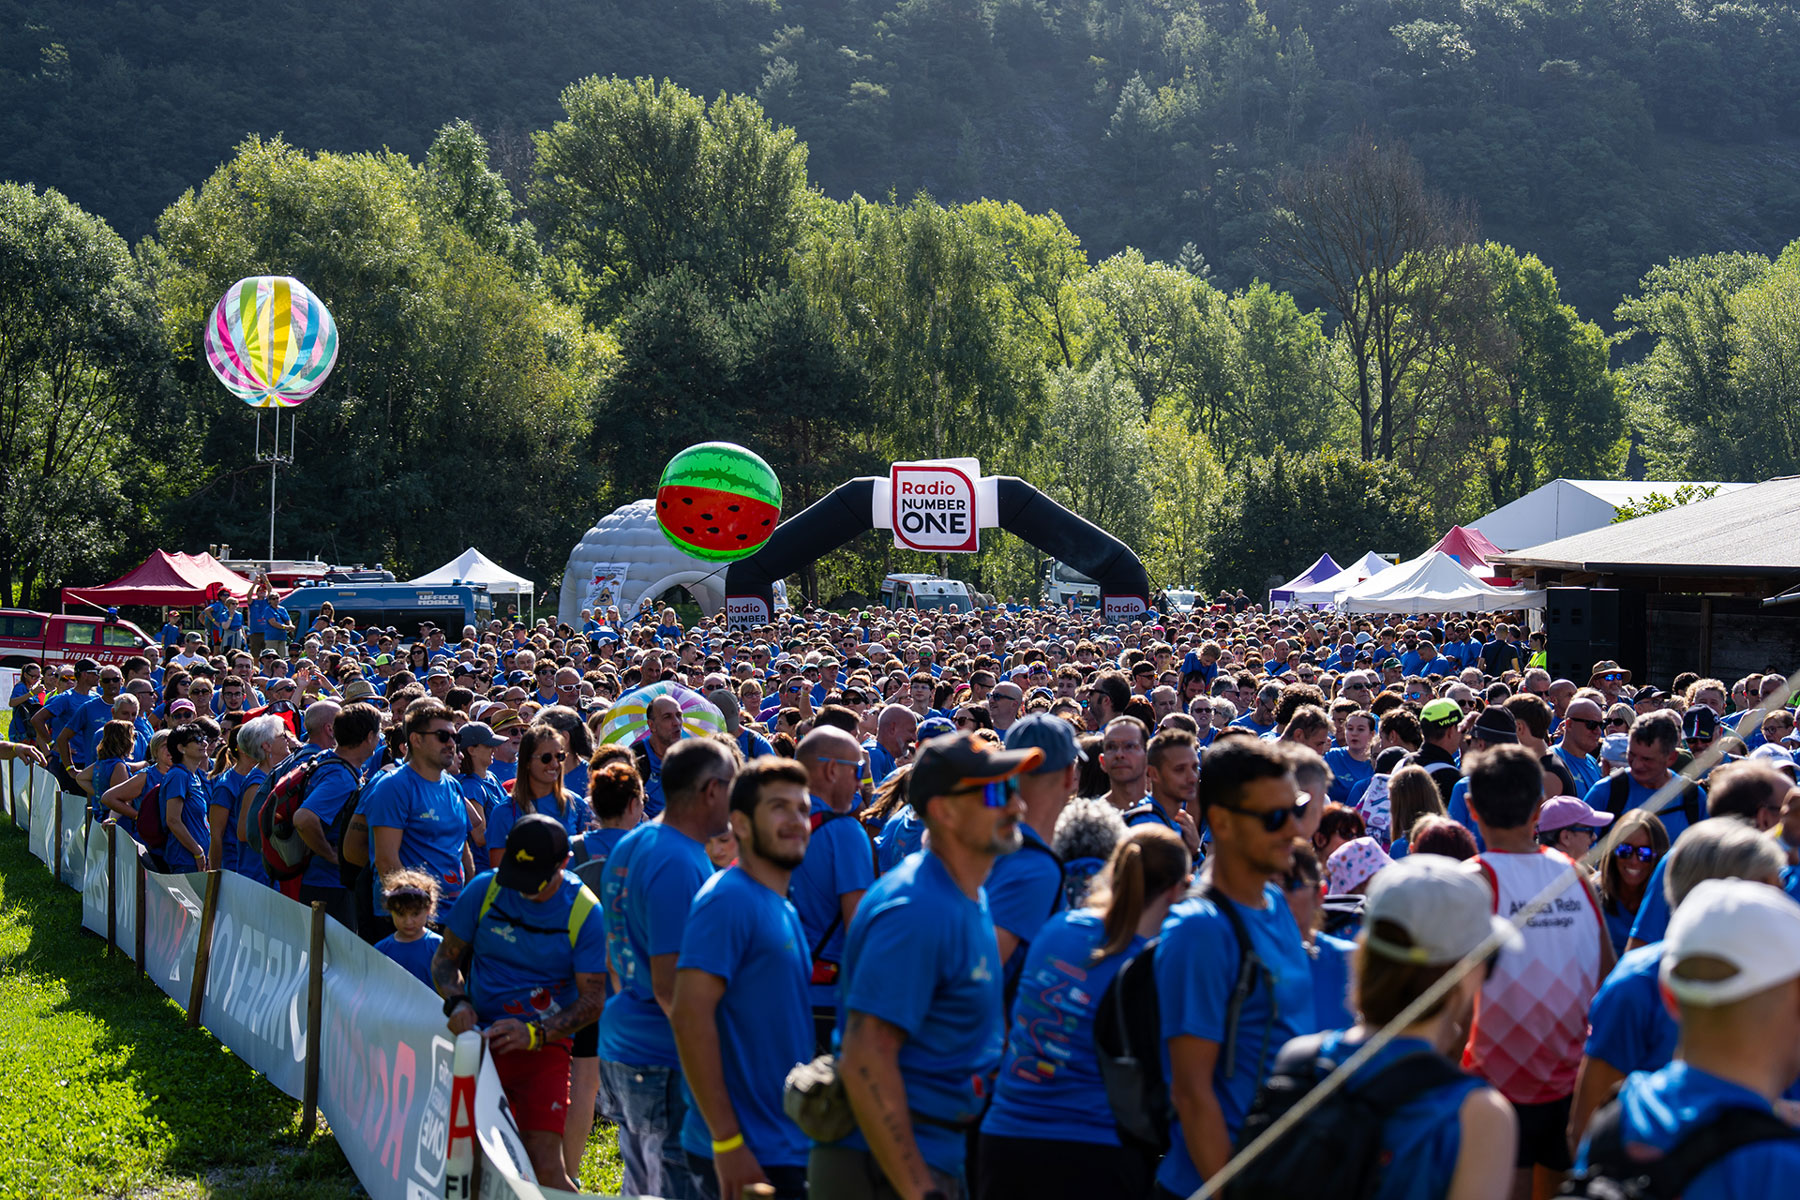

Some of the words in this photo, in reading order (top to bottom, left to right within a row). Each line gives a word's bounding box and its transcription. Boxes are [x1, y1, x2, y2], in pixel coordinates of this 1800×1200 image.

[902, 481, 955, 495] Radio
[902, 499, 966, 513] NUMBER
[902, 512, 966, 534] ONE
[728, 603, 760, 613] Radio
[1107, 603, 1140, 613] Radio
[728, 615, 767, 624] NUMBER
[65, 652, 95, 661] VIGILI
[98, 653, 113, 662] DEL
